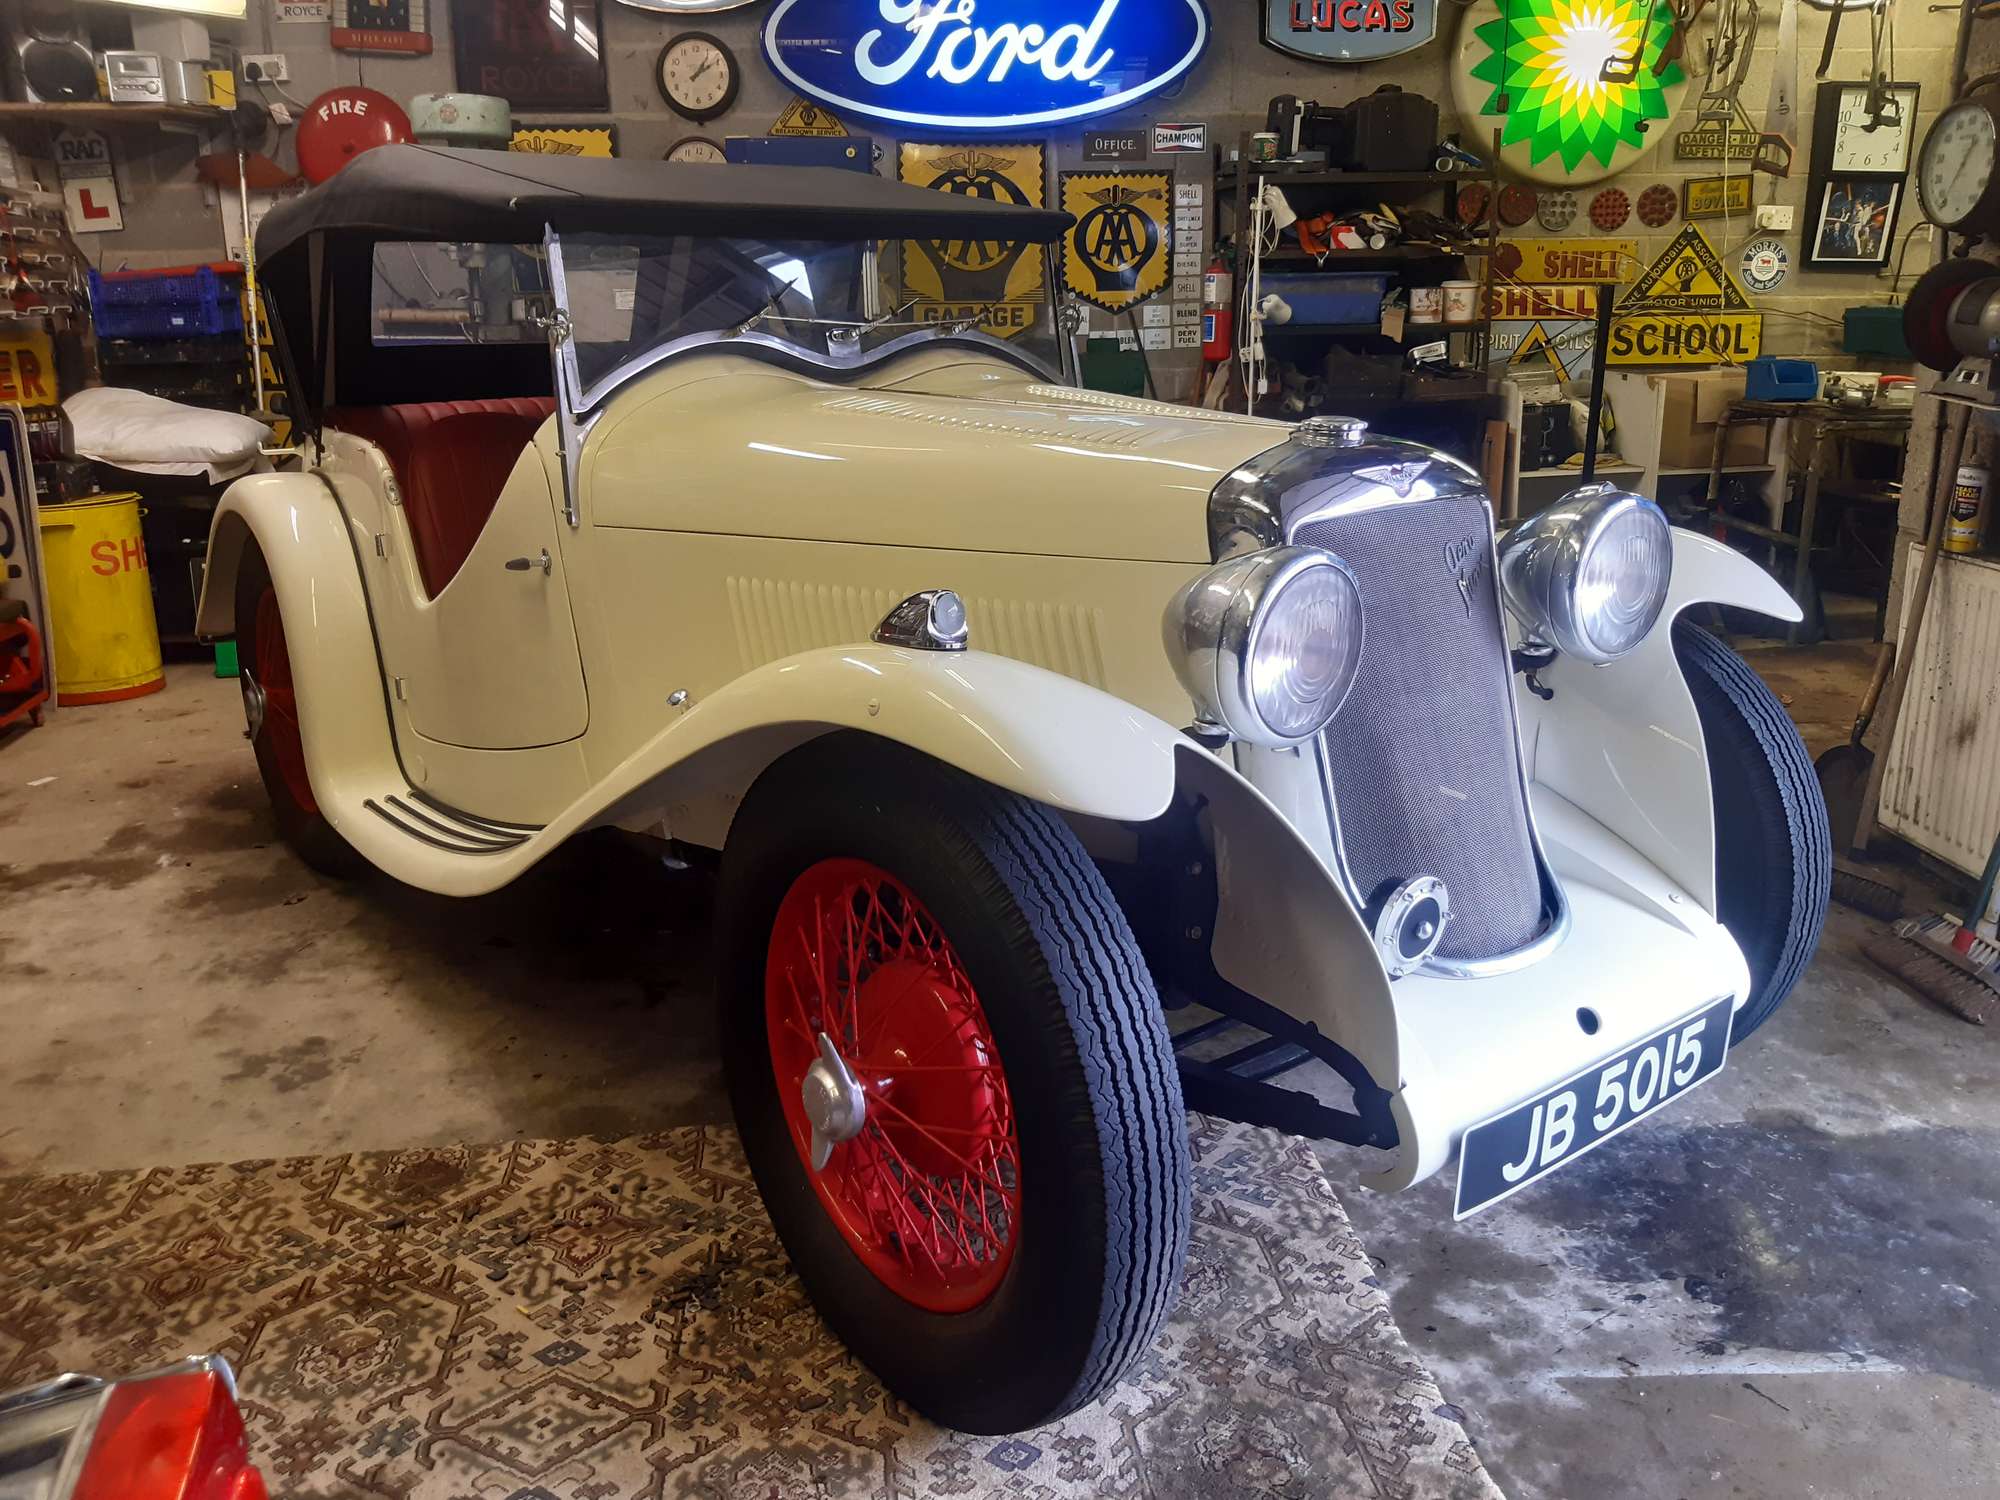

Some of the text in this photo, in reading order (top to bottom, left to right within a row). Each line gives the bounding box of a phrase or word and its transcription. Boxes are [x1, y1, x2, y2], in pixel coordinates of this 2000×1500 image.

[284, 6, 323, 17] ROYCE
[1290, 0, 1412, 31] LUCAS
[854, 0, 1114, 85] Ford
[1852, 95, 1863, 108] 11
[318, 99, 369, 122] FIRE
[1839, 110, 1851, 123] 10
[1156, 131, 1202, 144] CHAMPION
[1840, 125, 1847, 138] 9
[63, 138, 103, 160] RAC
[1727, 146, 1753, 157] FIRS
[1837, 140, 1845, 153] 8
[1892, 140, 1900, 153] 4
[1849, 152, 1857, 165] 7
[1863, 153, 1871, 166] 6
[1881, 153, 1889, 166] 5
[1179, 189, 1198, 199] SHELL
[79, 188, 110, 219] L
[1090, 209, 1142, 267] AA
[1748, 240, 1785, 259] MORRIS
[1625, 237, 1741, 307] THE AUTOMOBILE ASSOCATION AND
[1177, 283, 1196, 293] SHELL
[1481, 288, 1595, 316] SHELL
[1176, 310, 1198, 318] BLEND
[1119, 336, 1136, 345] BLEN
[1556, 333, 1593, 350] OILS
[1611, 322, 1749, 356] SCHOOL
[1502, 1018, 1707, 1182] JB 5015
